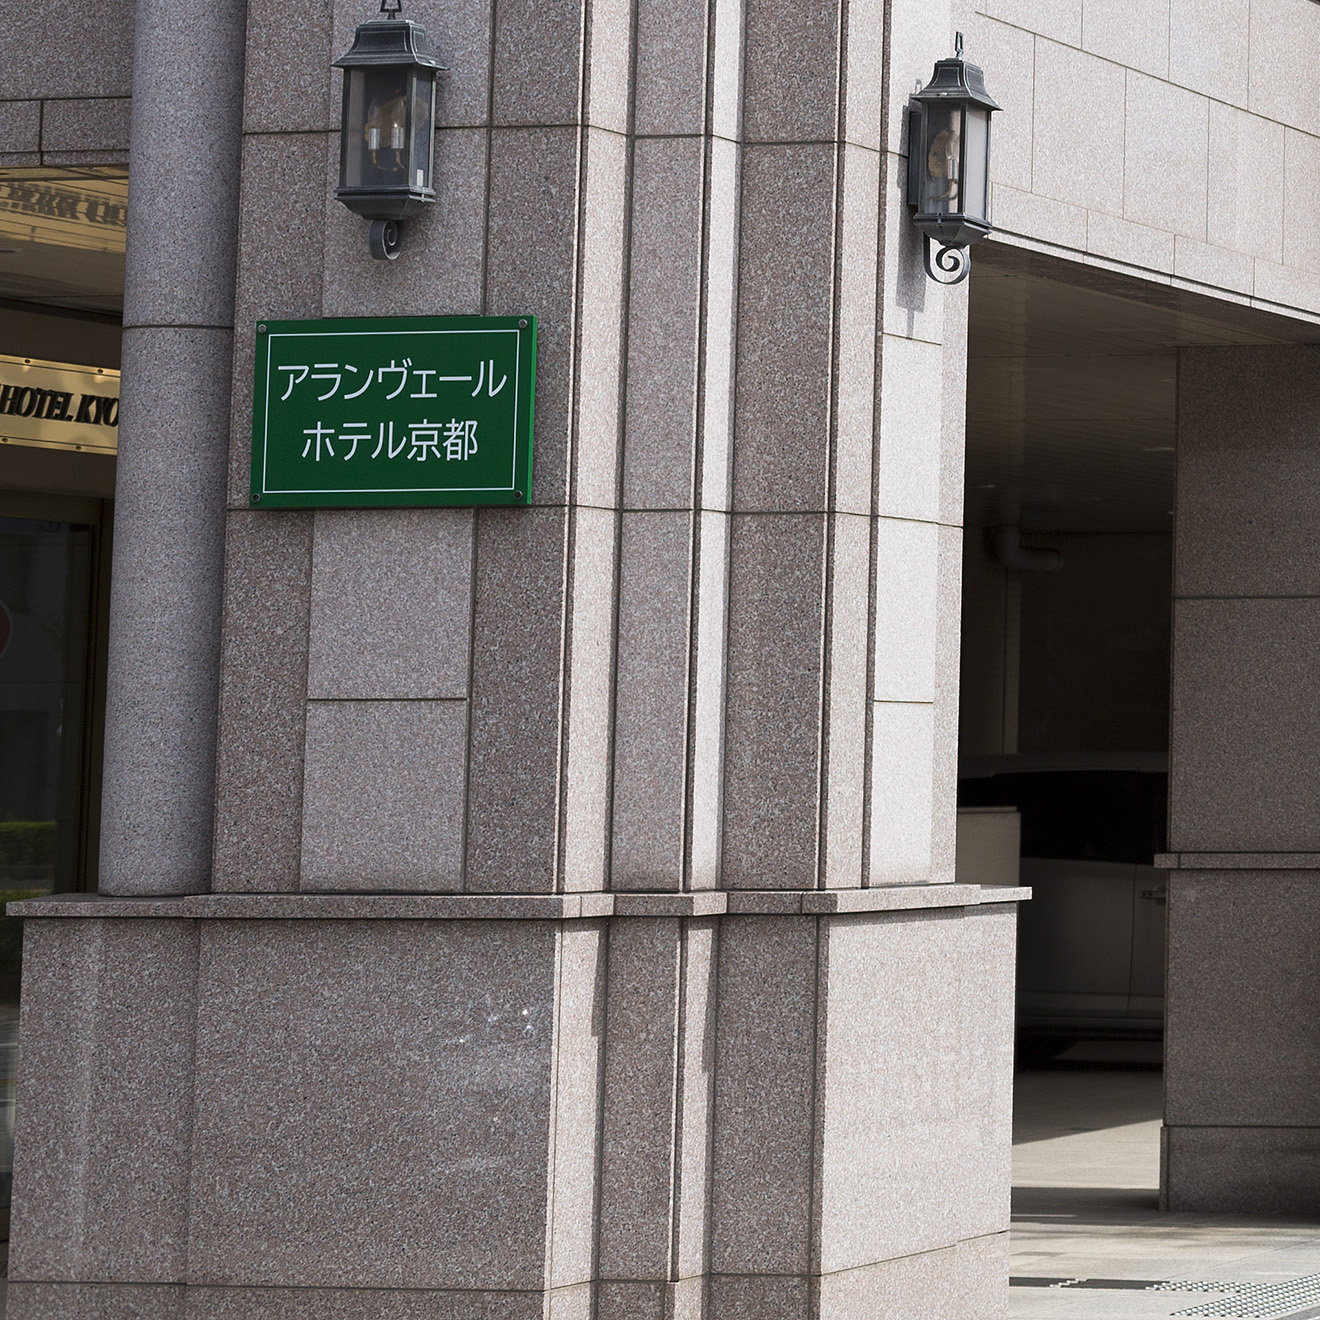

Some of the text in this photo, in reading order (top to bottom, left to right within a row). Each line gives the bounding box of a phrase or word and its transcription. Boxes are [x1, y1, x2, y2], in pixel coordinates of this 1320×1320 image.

[277, 357, 508, 401] アランヴェール
[301, 418, 478, 461] ホテル京都
